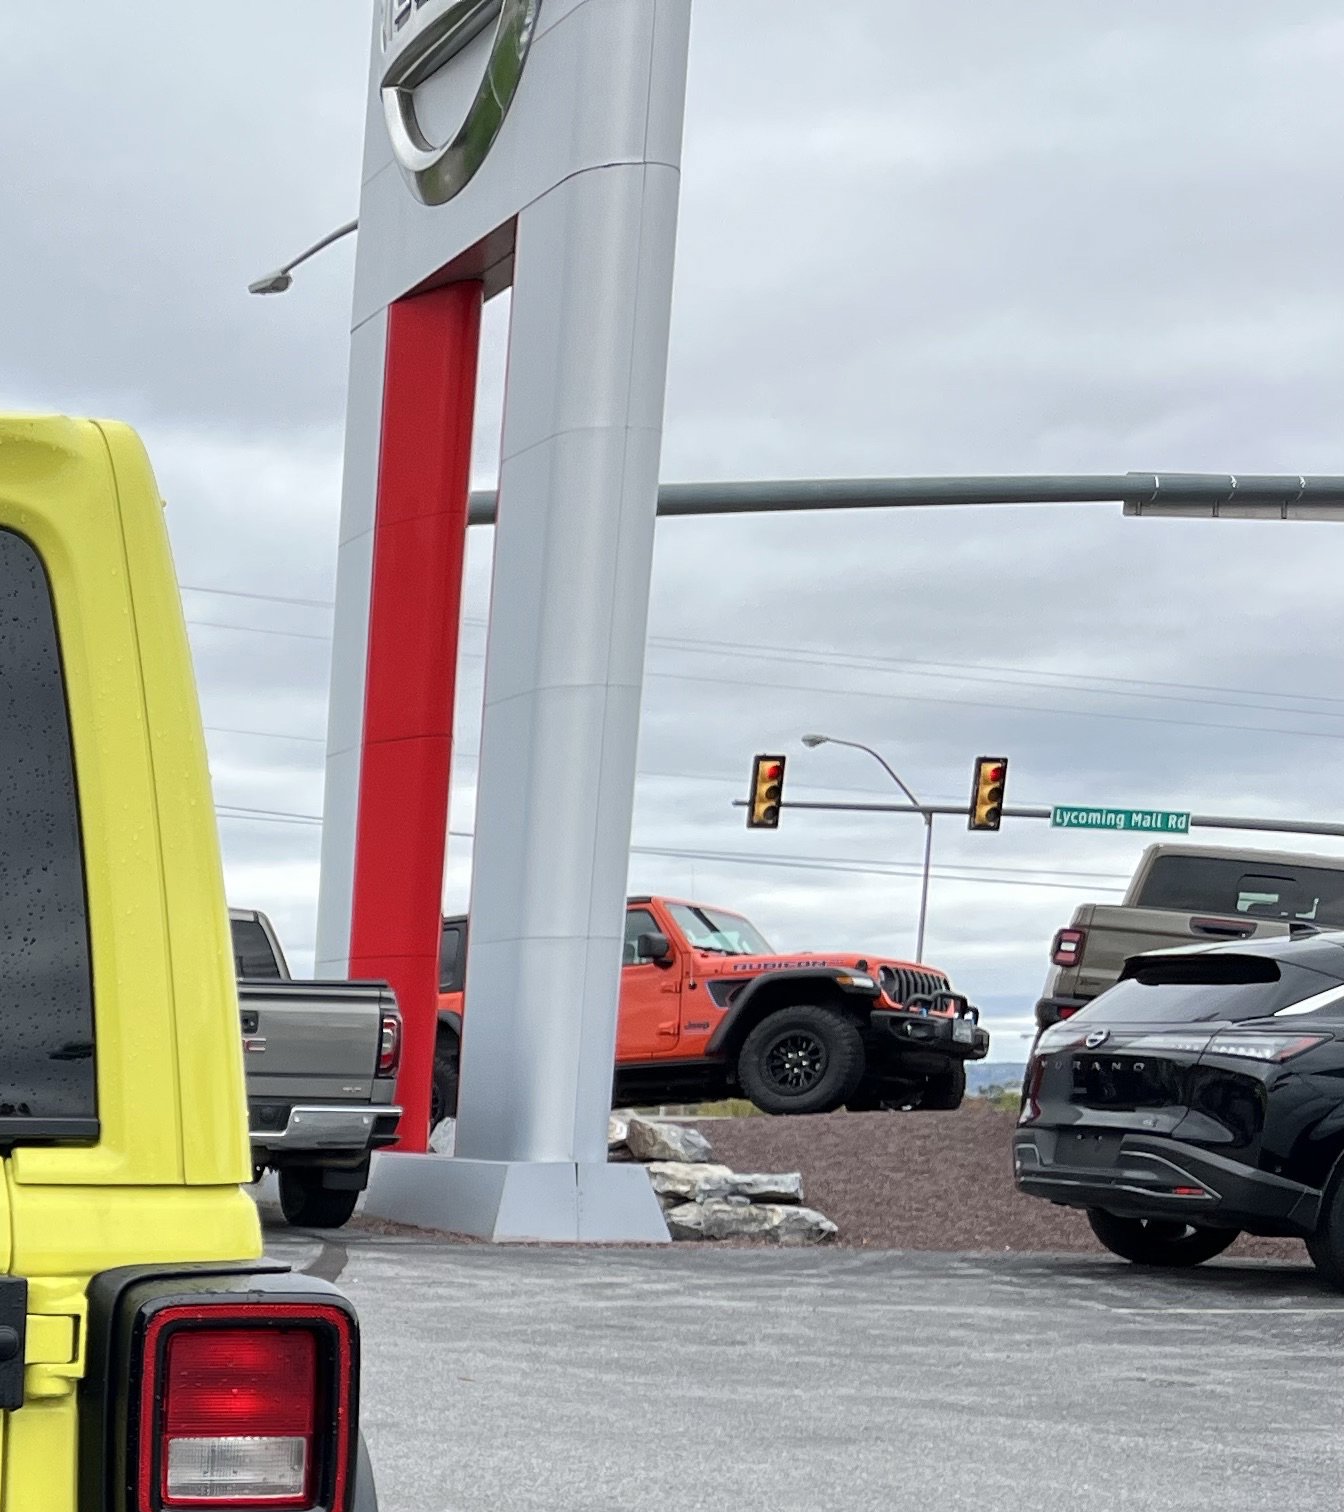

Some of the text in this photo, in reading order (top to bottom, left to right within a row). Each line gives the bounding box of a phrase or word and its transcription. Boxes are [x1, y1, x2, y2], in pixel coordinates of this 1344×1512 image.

[1055, 808, 1186, 829] Lycoming Mall Rd
